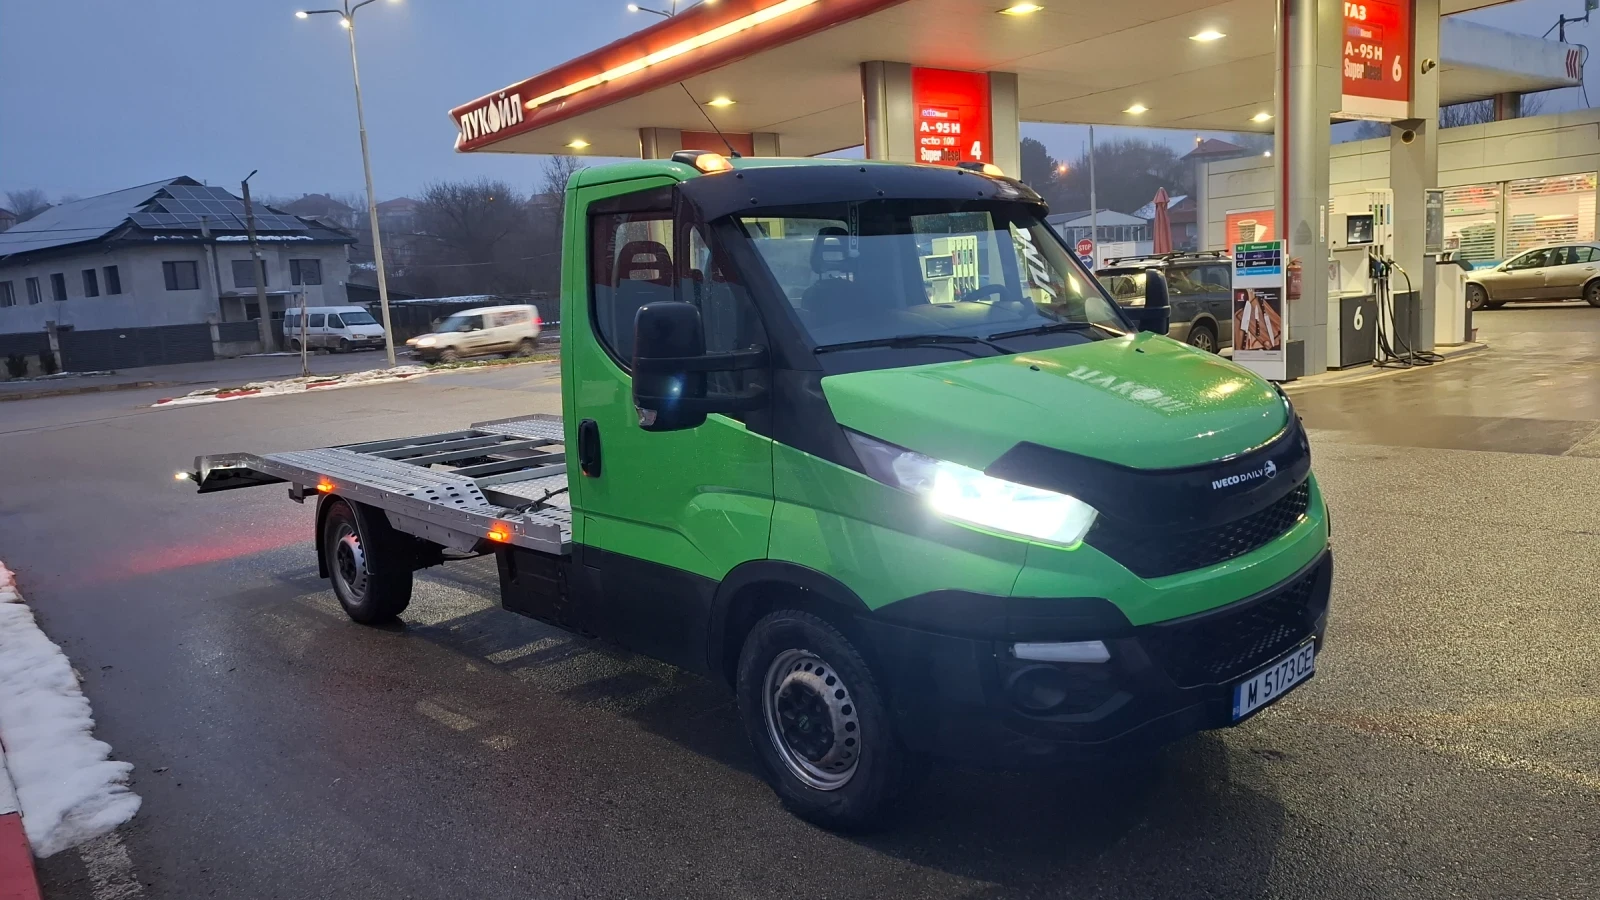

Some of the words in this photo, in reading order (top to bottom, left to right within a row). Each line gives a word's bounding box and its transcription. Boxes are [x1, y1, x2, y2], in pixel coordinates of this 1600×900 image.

[1344, 2, 1367, 20] ГАЗ
[1392, 55, 1402, 82] 6
[971, 140, 982, 160] 4
[1353, 306, 1363, 330] 6
[1212, 475, 1240, 490] IVECO
[1240, 468, 1263, 482] DAILY
[1248, 680, 1258, 708] M
